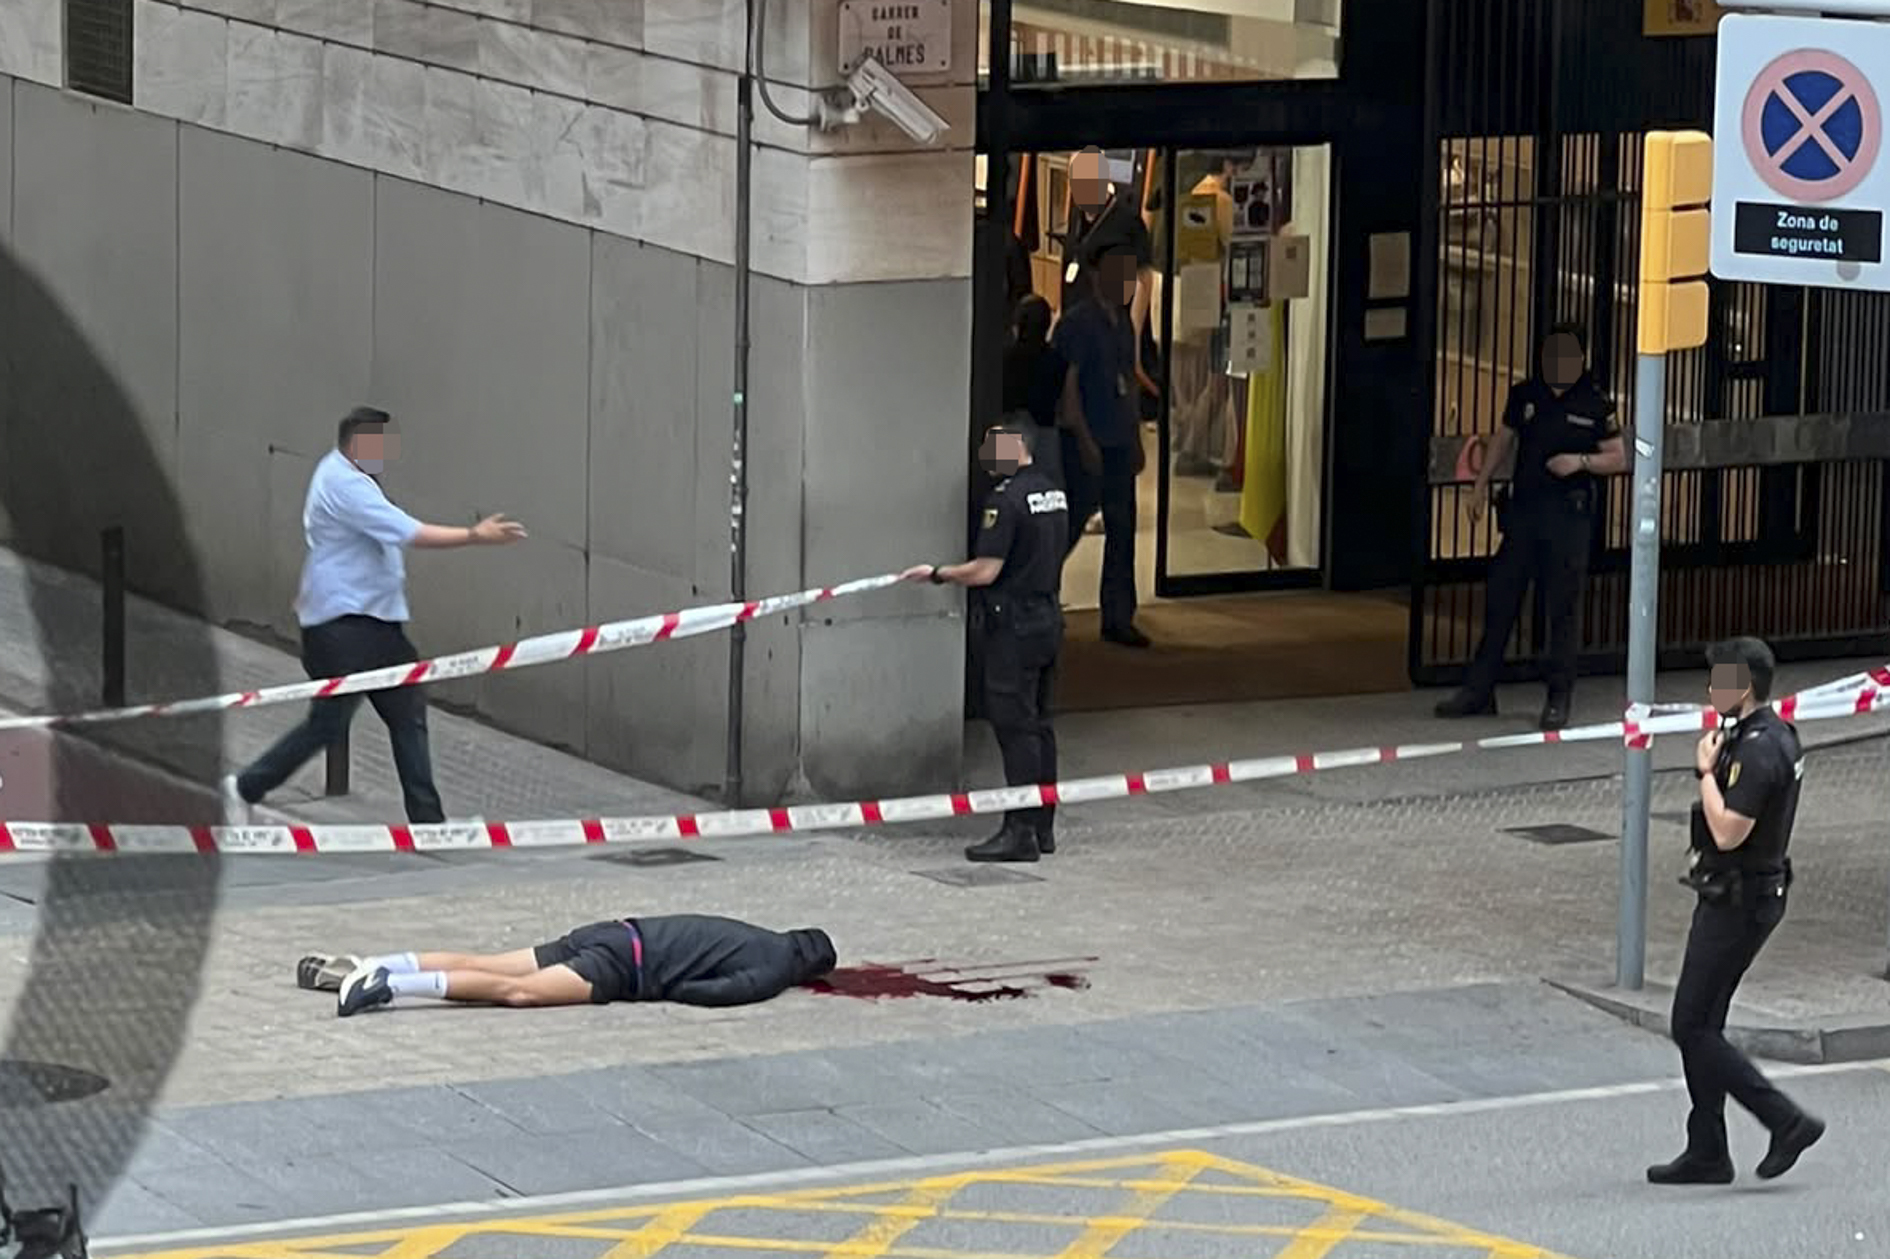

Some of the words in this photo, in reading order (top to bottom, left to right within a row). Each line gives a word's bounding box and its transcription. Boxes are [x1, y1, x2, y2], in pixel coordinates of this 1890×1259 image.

[872, 6, 919, 21] CARRER
[887, 26, 902, 39] DE
[1777, 211, 1816, 230] Zona
[1819, 215, 1839, 231] de
[1771, 236, 1843, 254] seguretat
